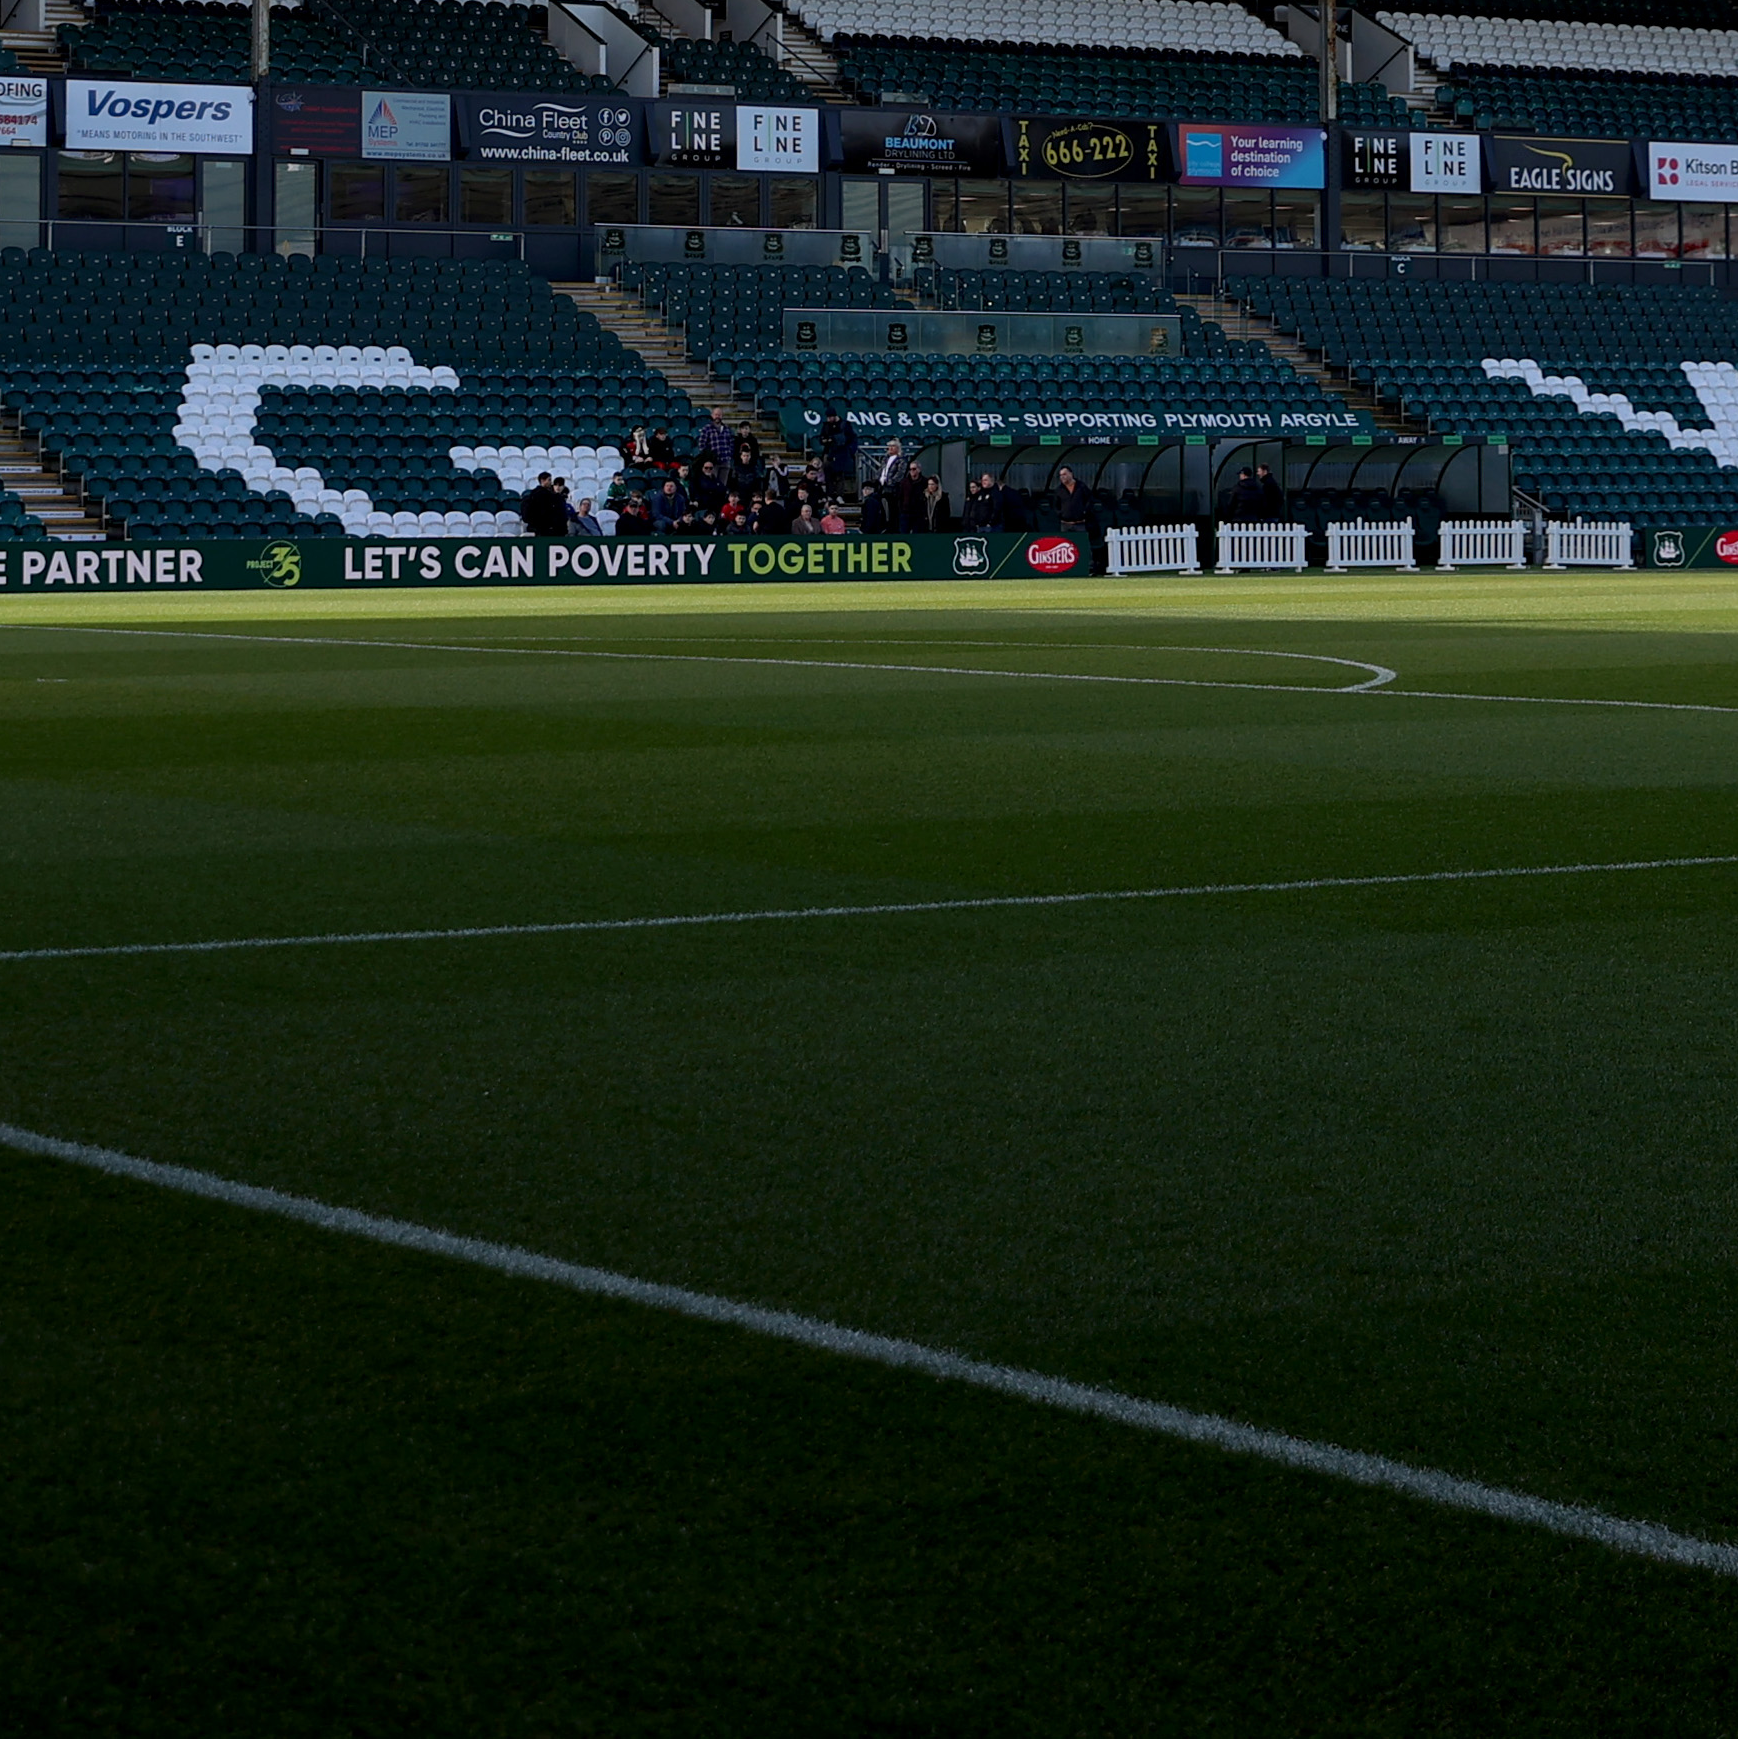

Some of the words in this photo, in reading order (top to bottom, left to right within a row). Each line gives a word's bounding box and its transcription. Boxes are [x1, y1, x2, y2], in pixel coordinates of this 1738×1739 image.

[87, 90, 232, 125] Vospers
[479, 108, 536, 127] China
[542, 111, 589, 130] Fleet
[113, 130, 157, 141] MOTORING
[159, 132, 168, 141] IN
[171, 132, 187, 141] THE
[368, 125, 399, 139] MEP
[542, 130, 571, 141] Country
[572, 130, 588, 140] Club
[884, 137, 955, 150] BEAUMONT
[1018, 120, 1030, 176] TAXI
[1046, 134, 1130, 166] 666-222
[1230, 136, 1257, 149] Your
[1258, 137, 1304, 154] learning
[480, 146, 629, 163] www.china-fleet.co.uk
[884, 149, 936, 160] DRYLINING
[938, 151, 955, 161] LTD
[1147, 125, 1158, 180] TAXI
[1230, 151, 1291, 164] destination
[1230, 164, 1243, 177] of
[1244, 166, 1280, 178] choice
[1685, 159, 1727, 175] Kitson
[1510, 167, 1561, 190] EAGLE
[1566, 169, 1615, 192] SIGNS
[846, 412, 893, 428] ANG
[898, 412, 914, 427] &
[917, 413, 1006, 430] POTTER
[1024, 413, 1156, 429] SUPPORTING
[1166, 413, 1272, 428] PLYMOUTH
[1280, 413, 1360, 427] ARGYLE
[1088, 436, 1111, 445] HOME
[22, 549, 204, 585] PARTNER
[345, 544, 442, 580] LET'S
[455, 544, 534, 579] CAN
[548, 543, 717, 578] POVERTY
[727, 541, 913, 576] TOGETHER
